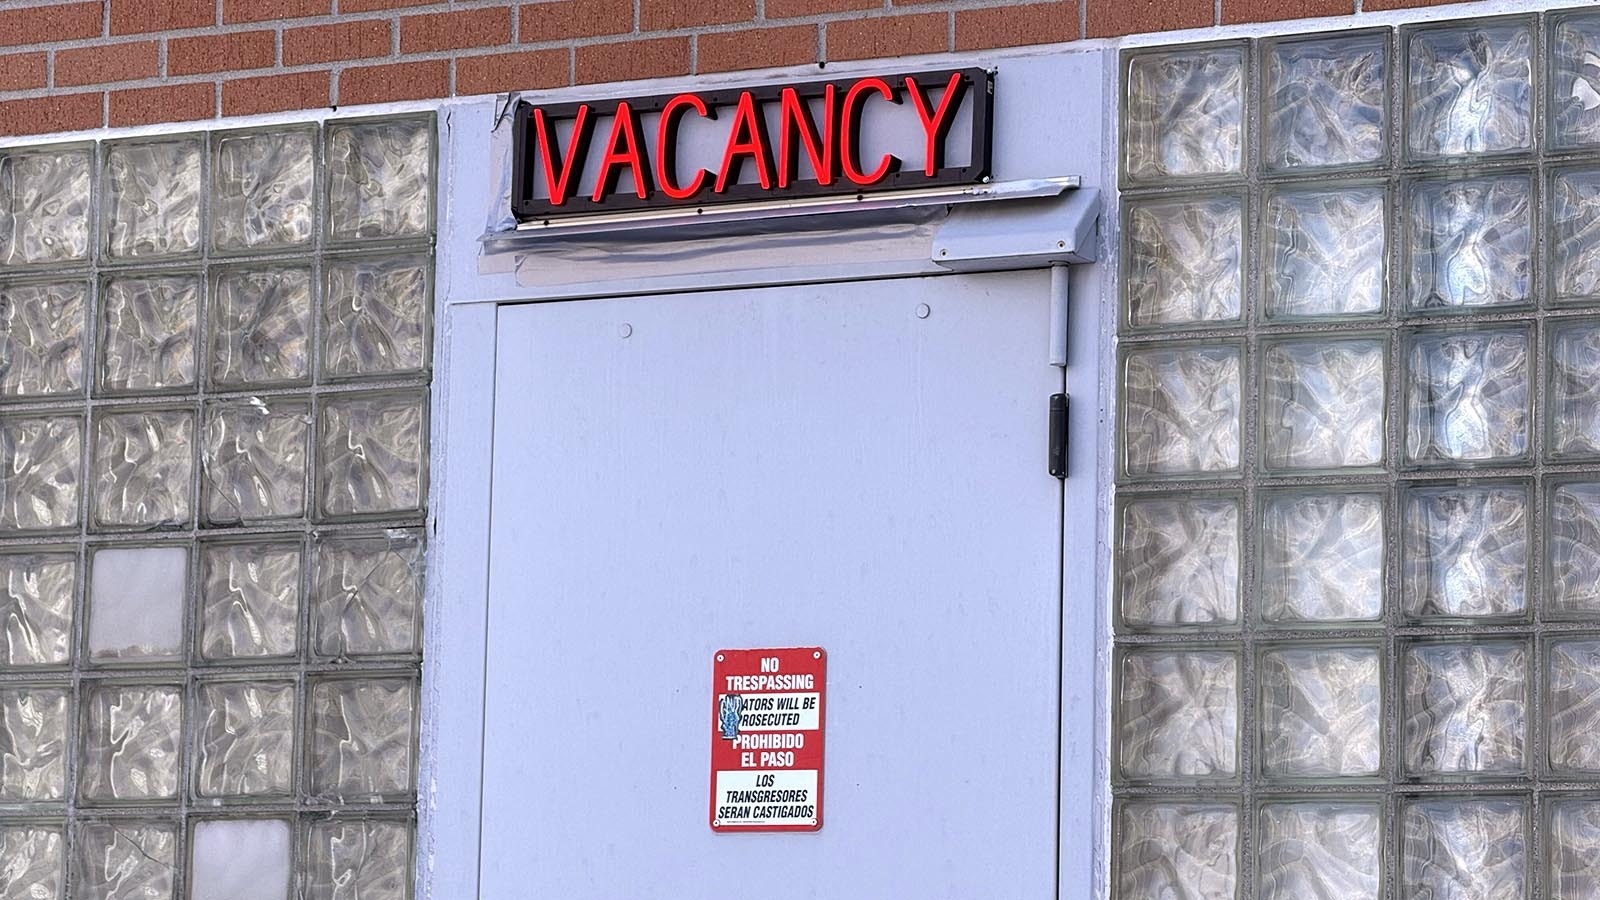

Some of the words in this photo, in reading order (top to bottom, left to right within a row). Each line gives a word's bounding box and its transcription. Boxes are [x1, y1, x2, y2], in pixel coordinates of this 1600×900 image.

[533, 73, 962, 205] VACANCY
[761, 657, 779, 673] NO
[725, 674, 814, 691] TRESPASSING
[720, 698, 774, 711] ATORS
[777, 697, 799, 710] WILL
[802, 697, 816, 710] BE
[740, 713, 800, 727] ROSECUTED
[732, 733, 804, 750] PROHIBIDO
[741, 752, 757, 767] EL
[760, 751, 794, 767] PASO
[756, 774, 775, 787] LOS
[726, 789, 808, 803] TRANSGRESORES
[718, 806, 751, 819] SERAN
[753, 805, 814, 818] CASTIGADOS
